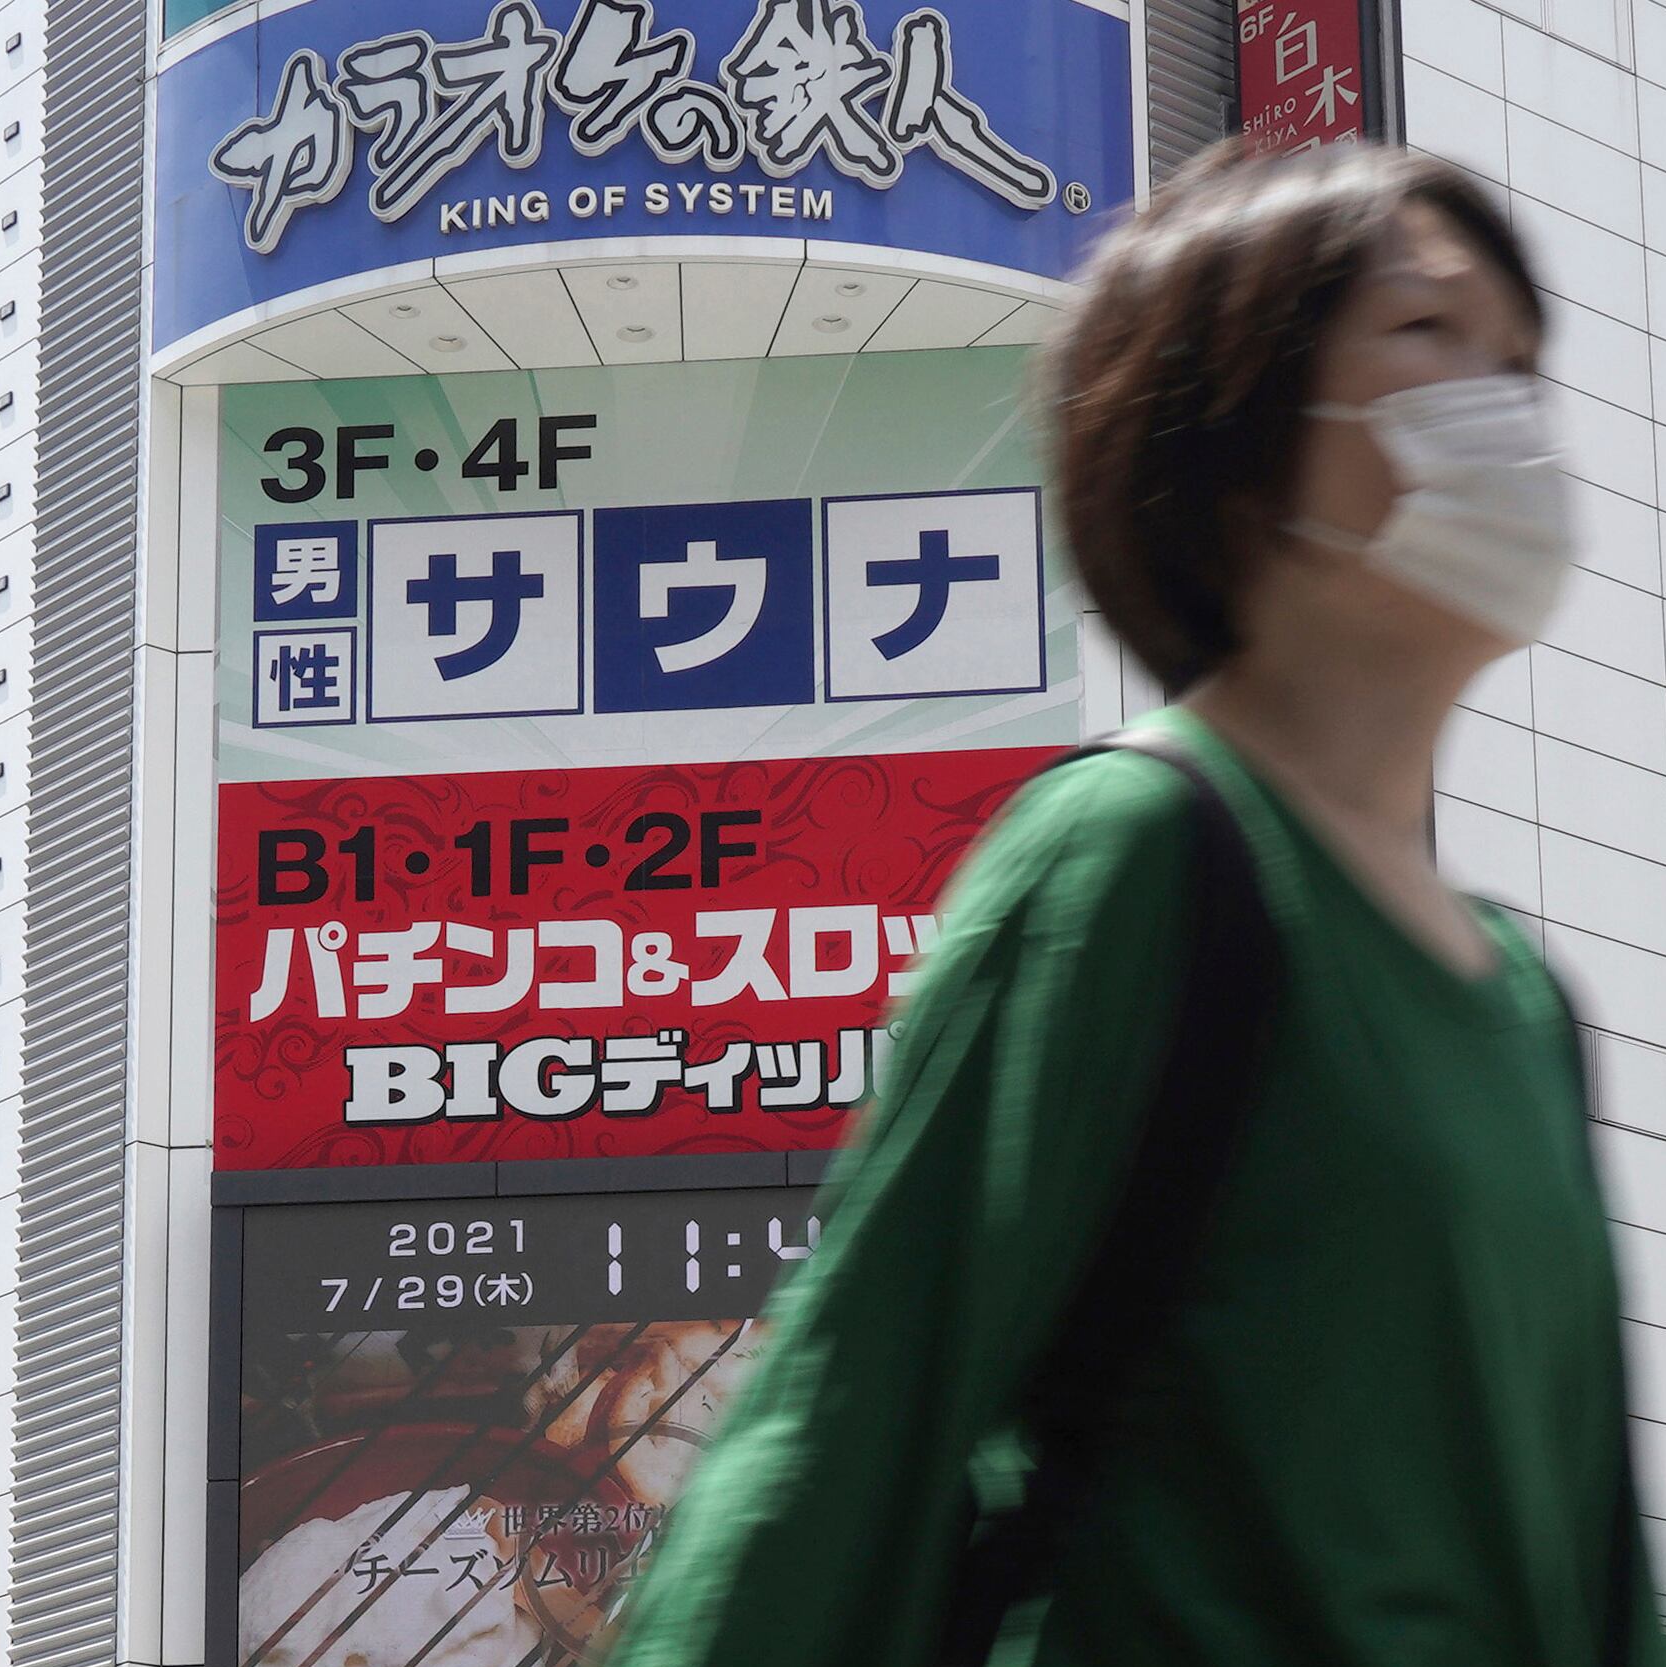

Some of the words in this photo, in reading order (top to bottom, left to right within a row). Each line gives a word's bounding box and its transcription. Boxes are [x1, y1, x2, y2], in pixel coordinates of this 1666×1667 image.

[1240, 5, 1274, 43] 6F
[209, 0, 1057, 254] カラオケの鉄人
[1275, 12, 1359, 157] 白木
[438, 190, 549, 234] KING
[567, 186, 627, 217] OF
[645, 181, 834, 220] SYSTEM
[269, 537, 340, 712] 男性
[406, 530, 1000, 682] サウナ
[389, 1219, 527, 1256] 2021
[320, 1273, 533, 1313] 7/29(木)
